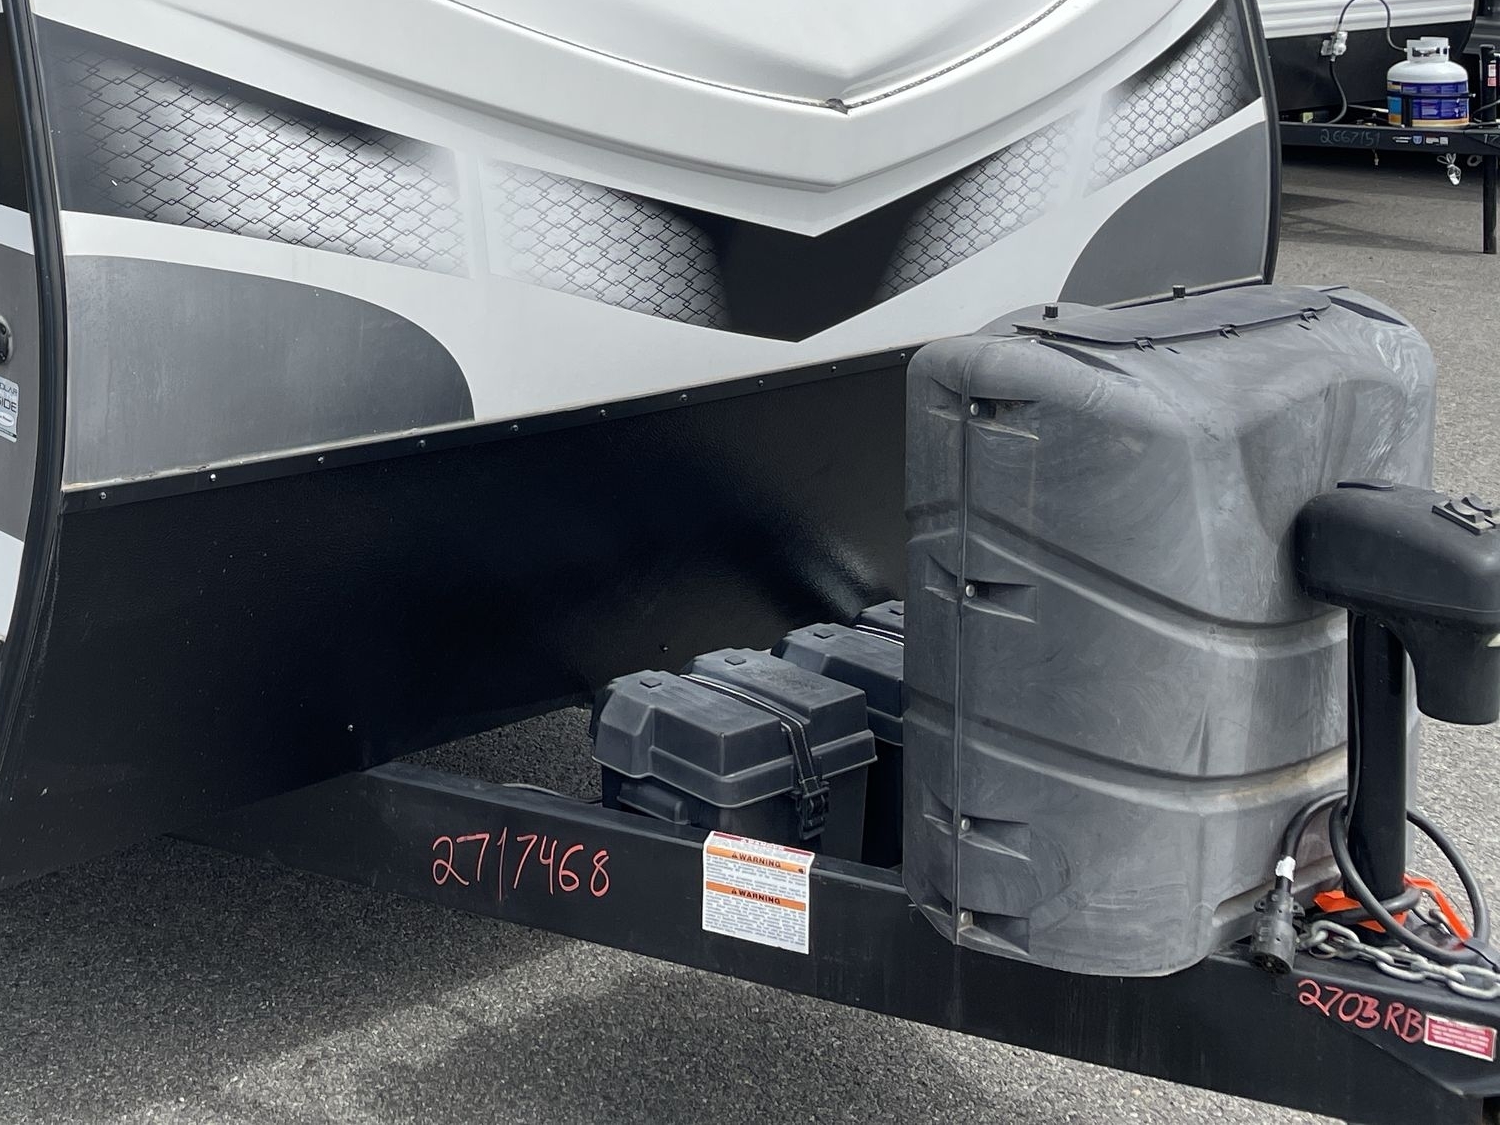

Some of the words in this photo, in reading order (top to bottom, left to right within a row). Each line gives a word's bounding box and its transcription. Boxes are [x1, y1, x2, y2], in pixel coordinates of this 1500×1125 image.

[432, 826, 610, 901] 2717468
[739, 852, 782, 868] WARNING
[738, 888, 781, 905] WARNING
